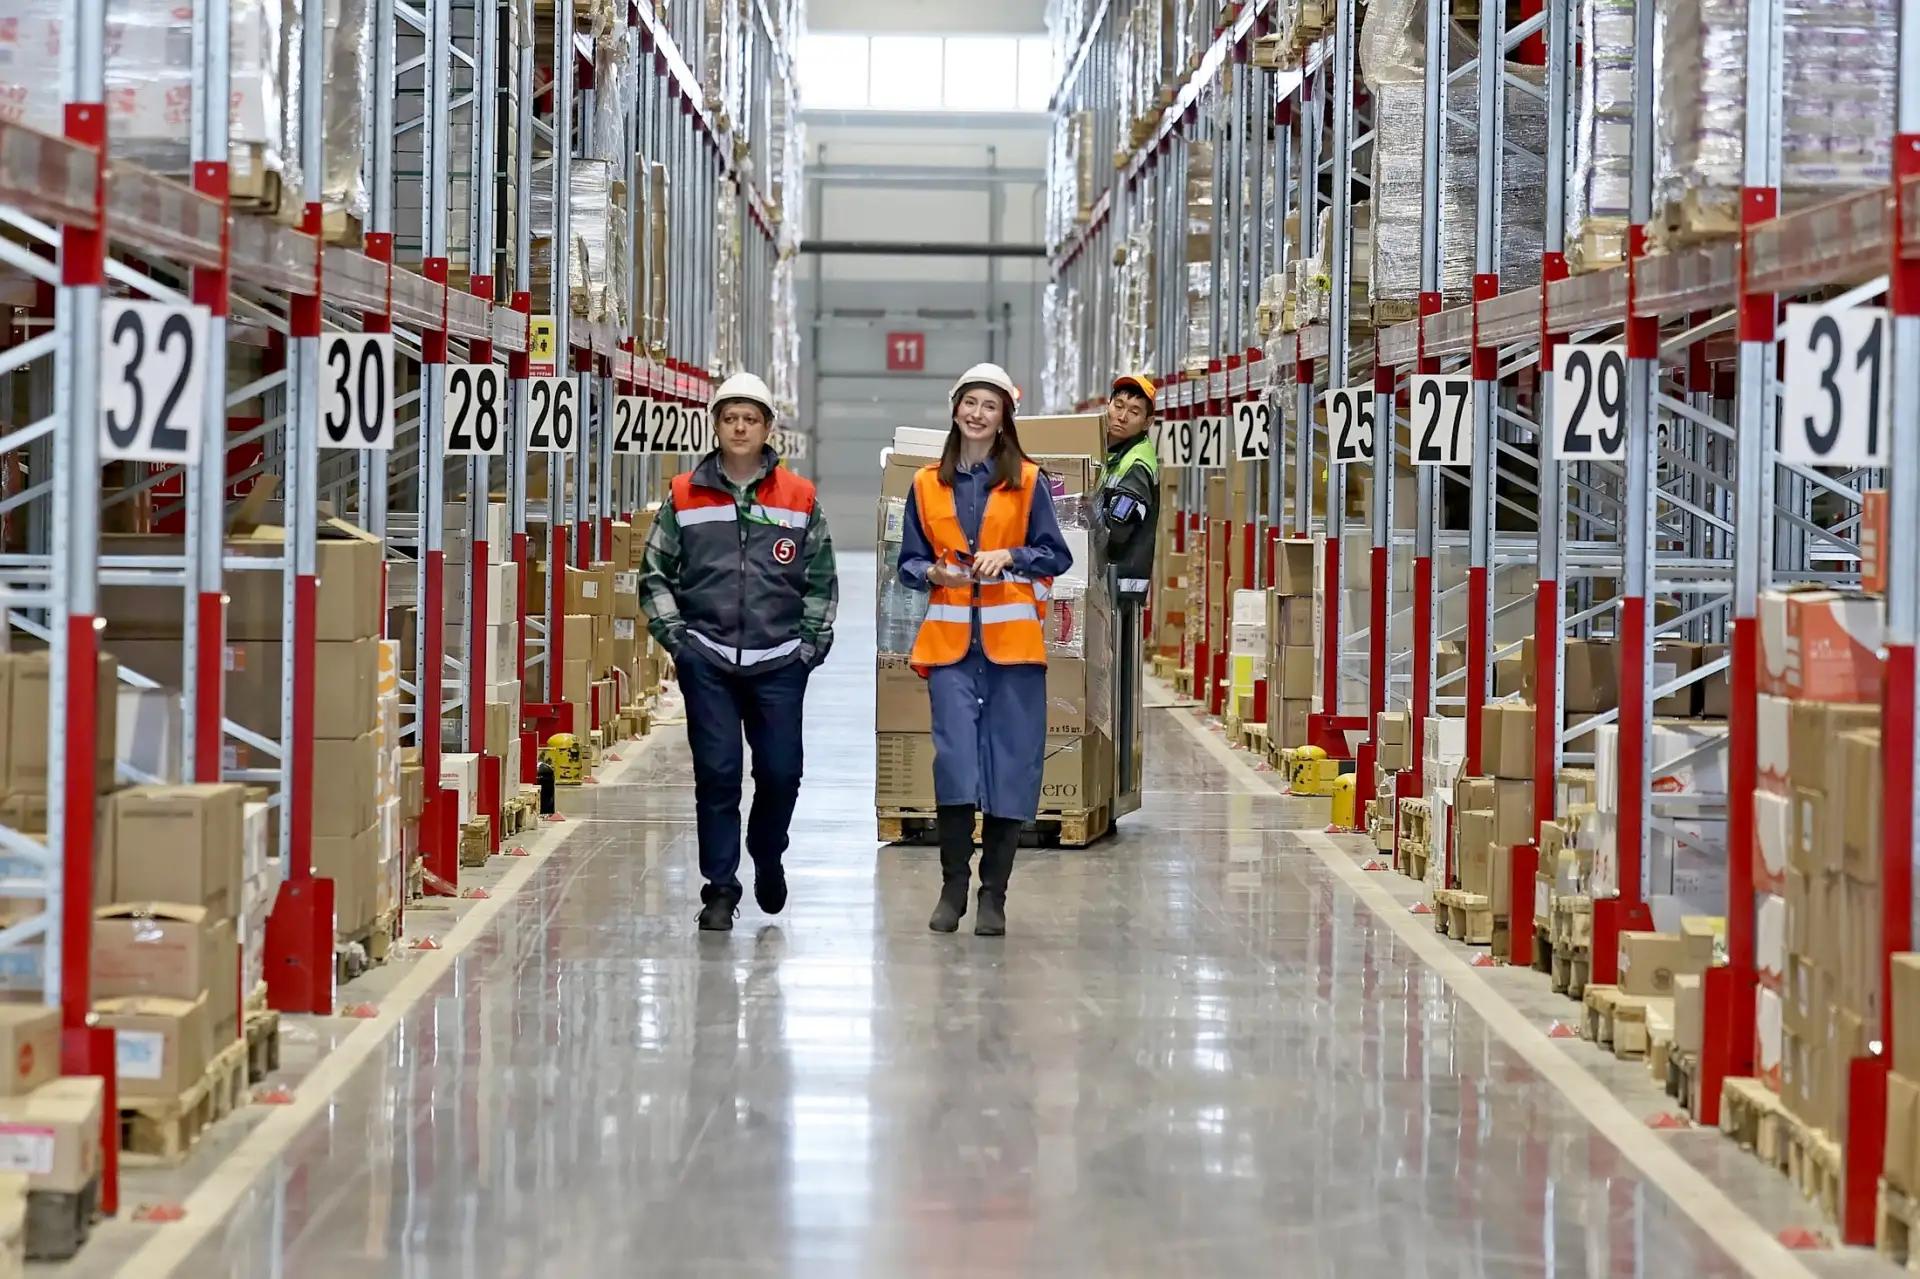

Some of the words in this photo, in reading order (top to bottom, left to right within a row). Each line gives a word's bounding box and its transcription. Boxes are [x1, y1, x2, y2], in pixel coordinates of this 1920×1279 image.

[894, 340, 918, 362] 11
[107, 310, 193, 451] 32
[325, 338, 385, 443] 30
[1562, 350, 1625, 454] 29
[1803, 315, 1884, 456] 31
[448, 368, 498, 452] 28
[531, 379, 573, 449] 26
[614, 398, 648, 453] 24
[650, 405, 679, 452] 22
[681, 410, 702, 452] 20
[1238, 403, 1270, 458] 23
[1332, 389, 1375, 460] 25
[1417, 379, 1469, 462] 27
[1167, 422, 1192, 465] 19
[1198, 418, 1221, 466] 21
[778, 540, 793, 559] 5
[1062, 724, 1070, 733] 15
